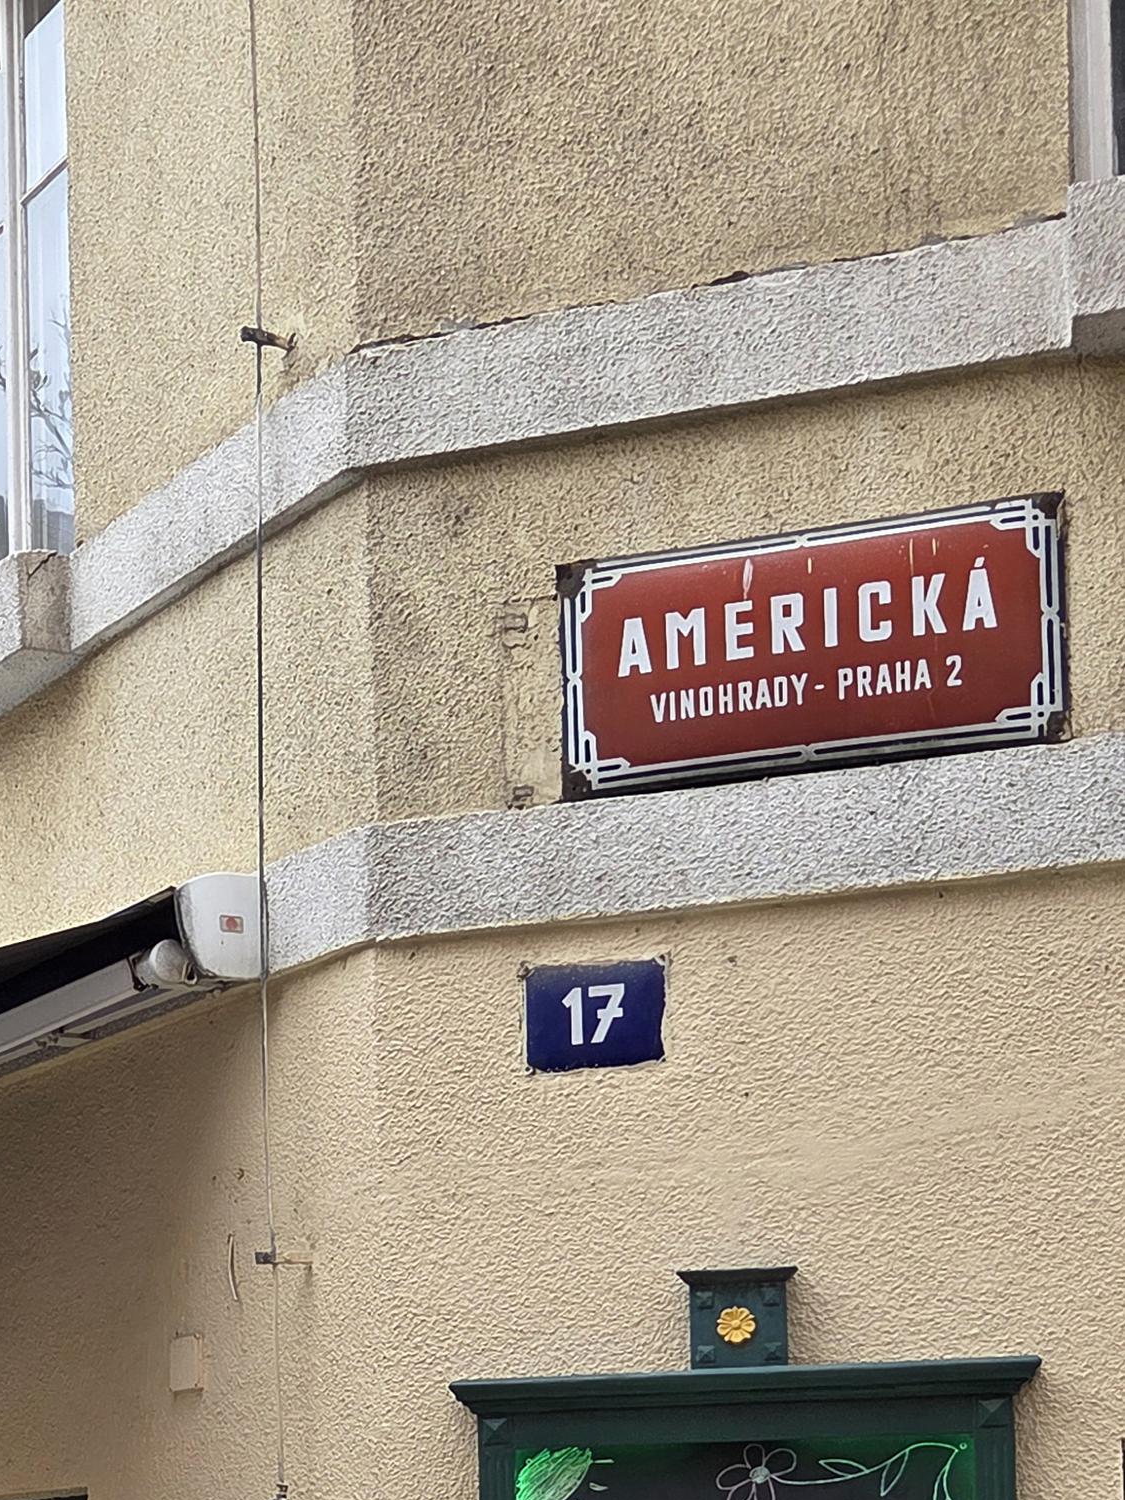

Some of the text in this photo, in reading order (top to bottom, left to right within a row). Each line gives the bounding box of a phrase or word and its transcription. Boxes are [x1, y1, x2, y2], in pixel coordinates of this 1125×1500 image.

[618, 556, 998, 678] AMERICKÁ
[650, 672, 809, 723] VINOHRADY
[838, 657, 933, 700] PRAHA
[945, 654, 963, 688] 2
[561, 983, 626, 1046] 17
